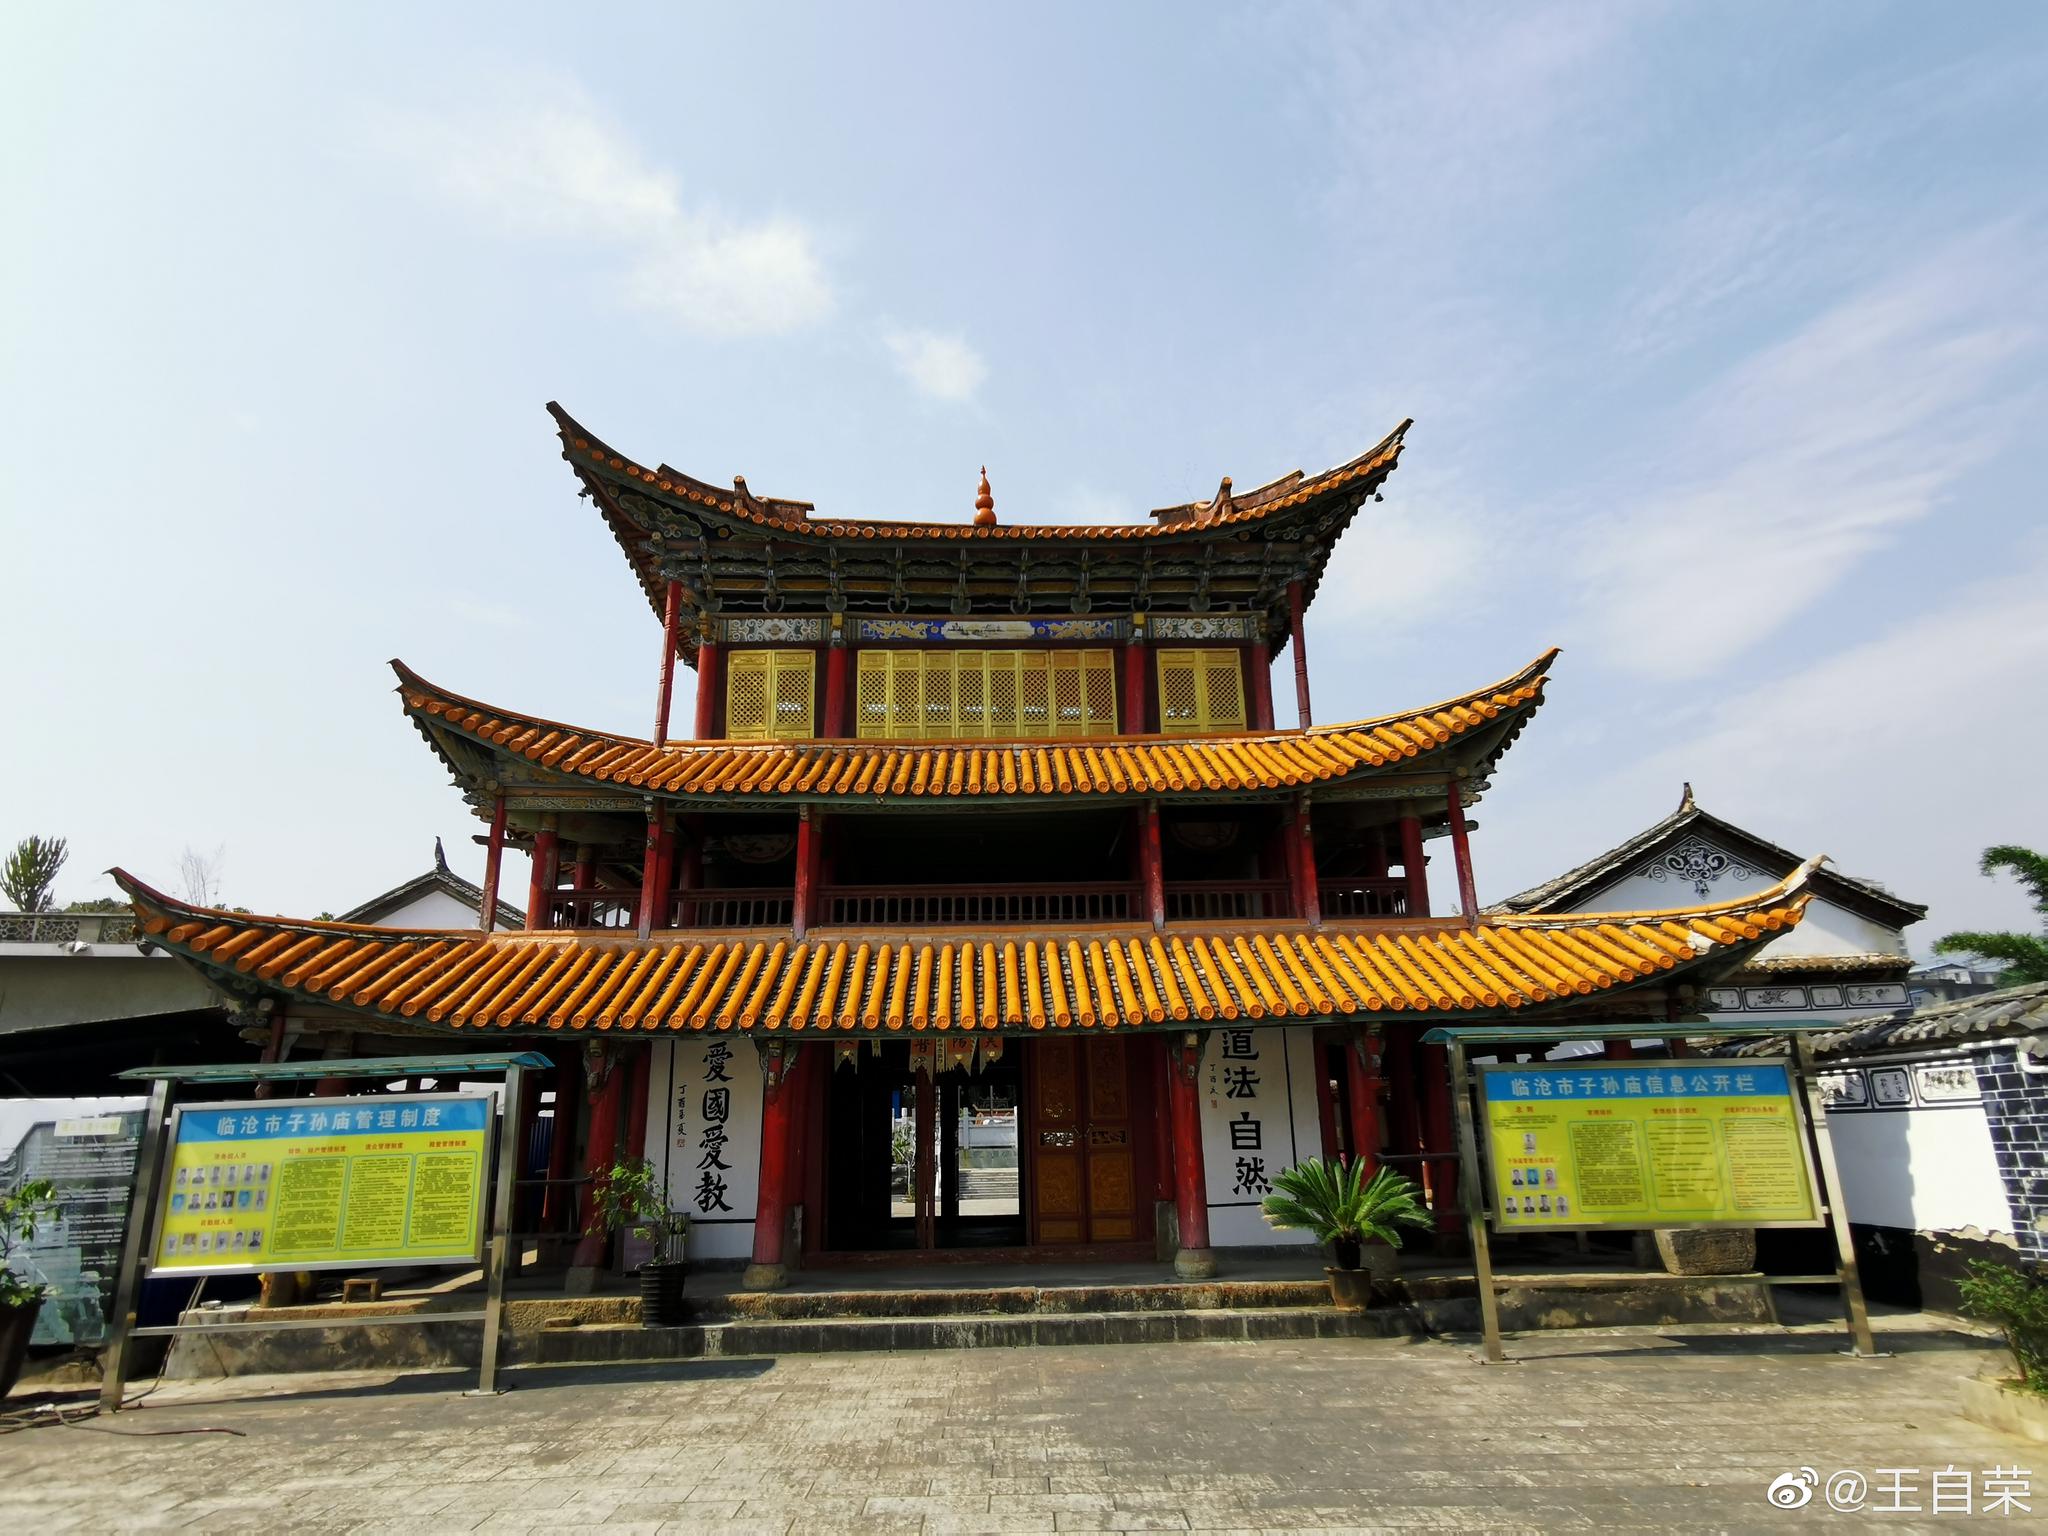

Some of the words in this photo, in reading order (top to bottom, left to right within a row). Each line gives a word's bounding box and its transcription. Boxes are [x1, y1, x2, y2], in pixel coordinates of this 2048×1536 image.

[216, 1107, 442, 1136] 临沧市子孙庙管理制度
[692, 1041, 734, 1213] 愛國愛教
[1222, 1029, 1274, 1195] 道法自然
[1511, 1074, 1756, 1096] 临沧市子孙庙信息公开栏
